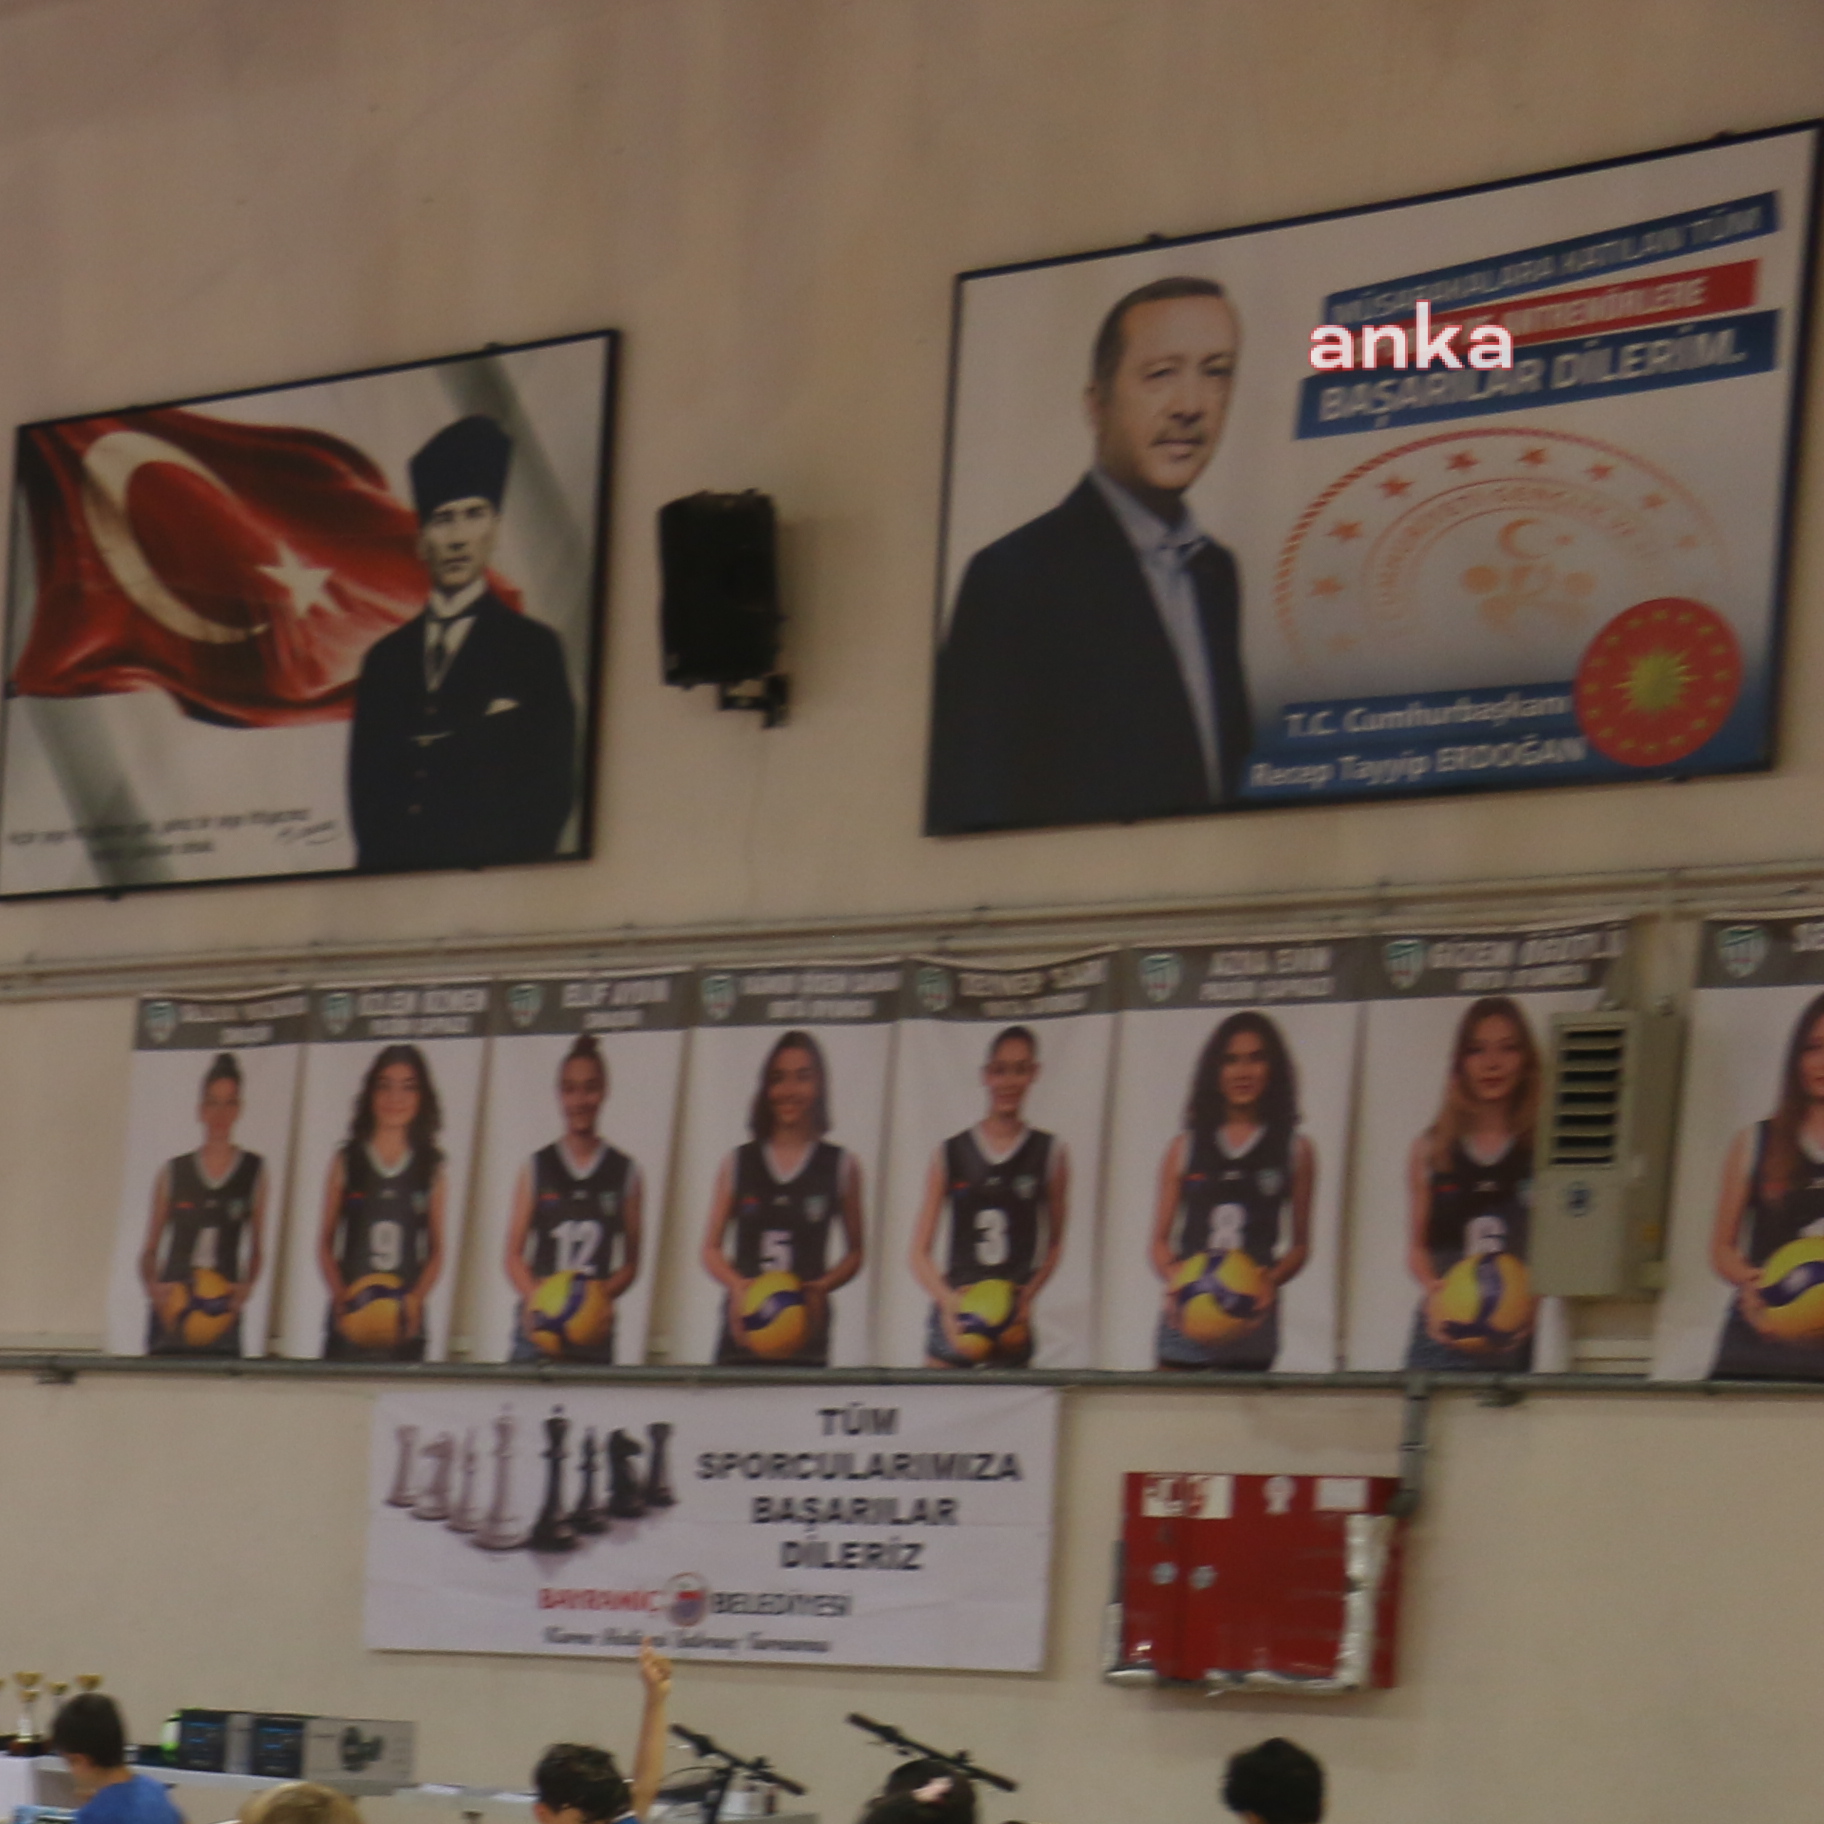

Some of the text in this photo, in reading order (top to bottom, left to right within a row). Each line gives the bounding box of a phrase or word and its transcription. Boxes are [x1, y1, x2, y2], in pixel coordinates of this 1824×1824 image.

[370, 1221, 402, 1270] 9
[553, 1221, 603, 1274] 12
[761, 1229, 793, 1272] 5
[974, 1207, 1009, 1265] 3
[817, 1402, 900, 1435] TÜM
[696, 1453, 1023, 1481] SPORCULARIMIZA
[751, 1497, 959, 1538] BAŞARILAR
[779, 1536, 926, 1570] DİLERİZ
